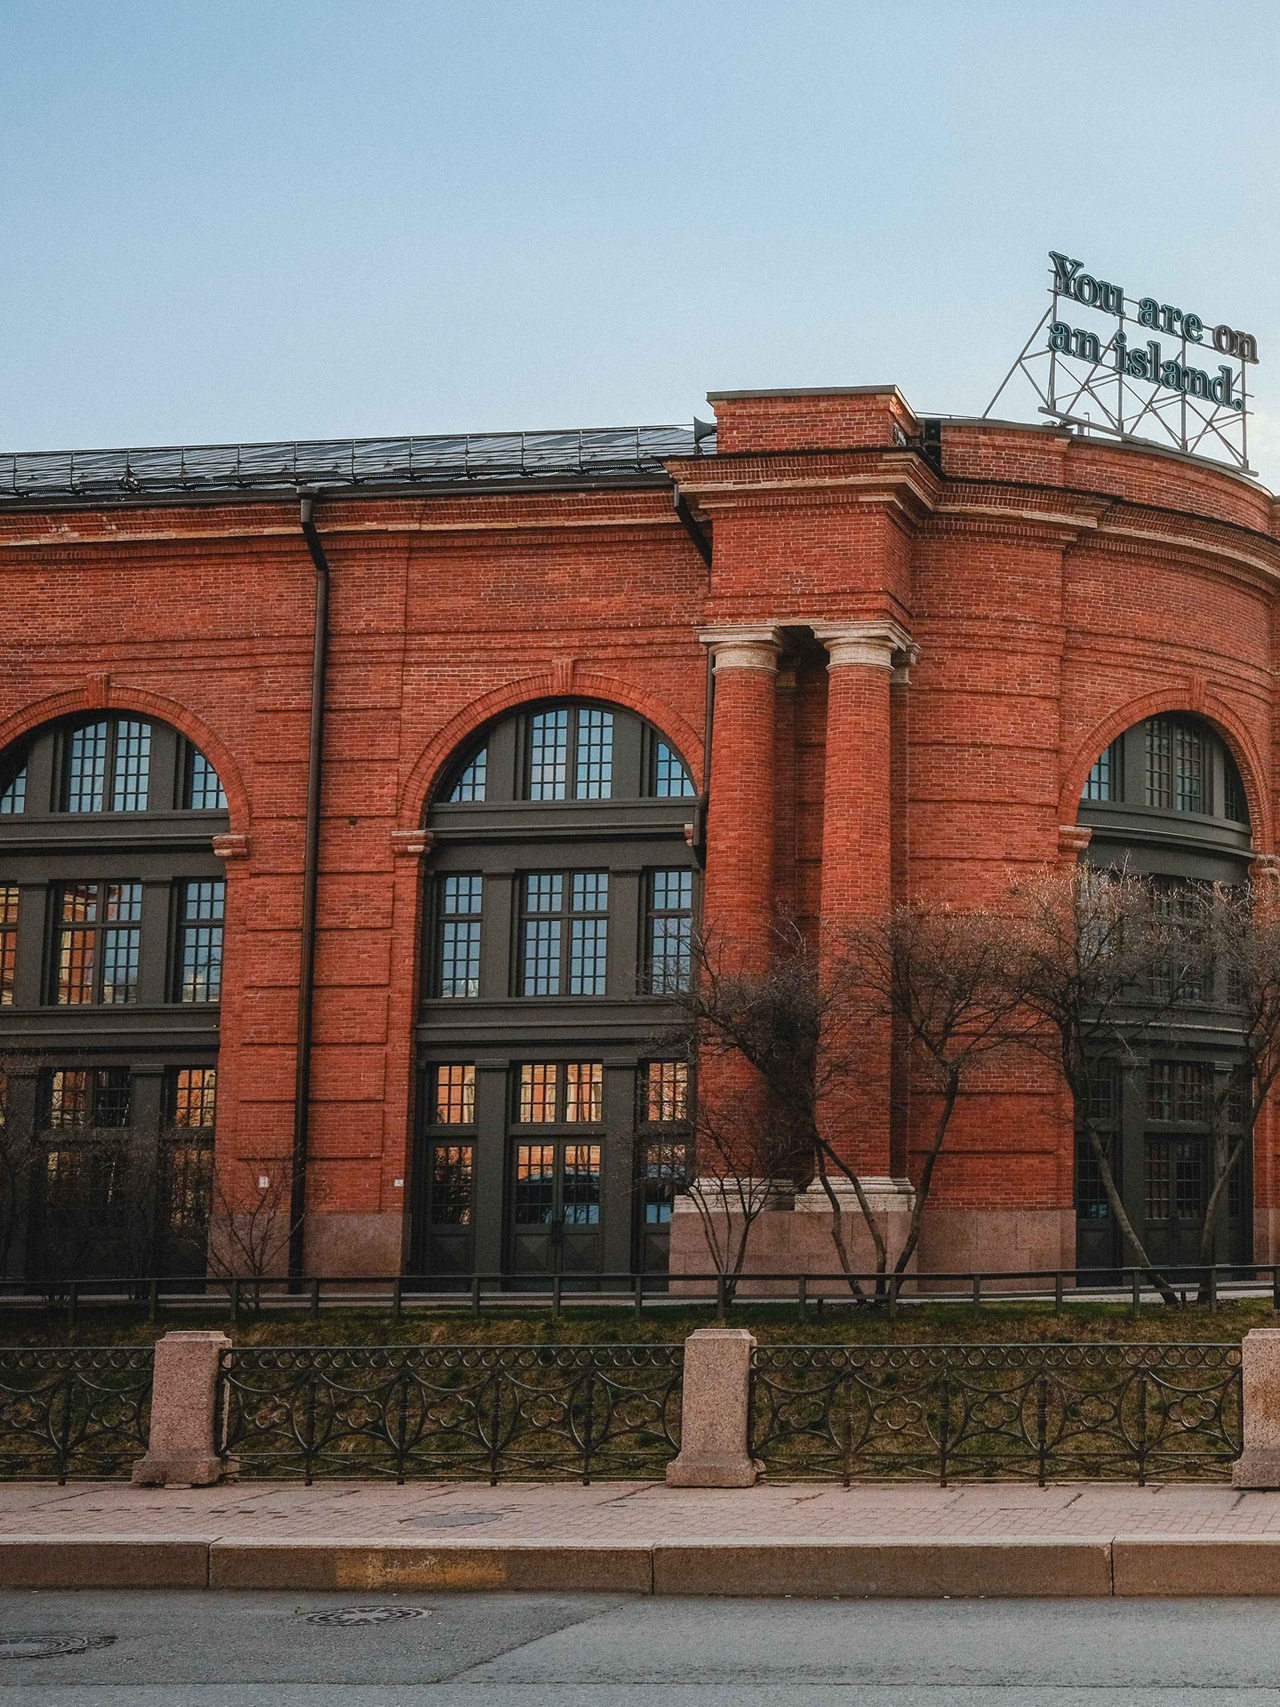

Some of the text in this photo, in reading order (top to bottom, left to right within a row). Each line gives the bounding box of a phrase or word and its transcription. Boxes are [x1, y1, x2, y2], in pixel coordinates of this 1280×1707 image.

[1049, 250, 1260, 365] You are on
[1048, 320, 1244, 412] an island.
